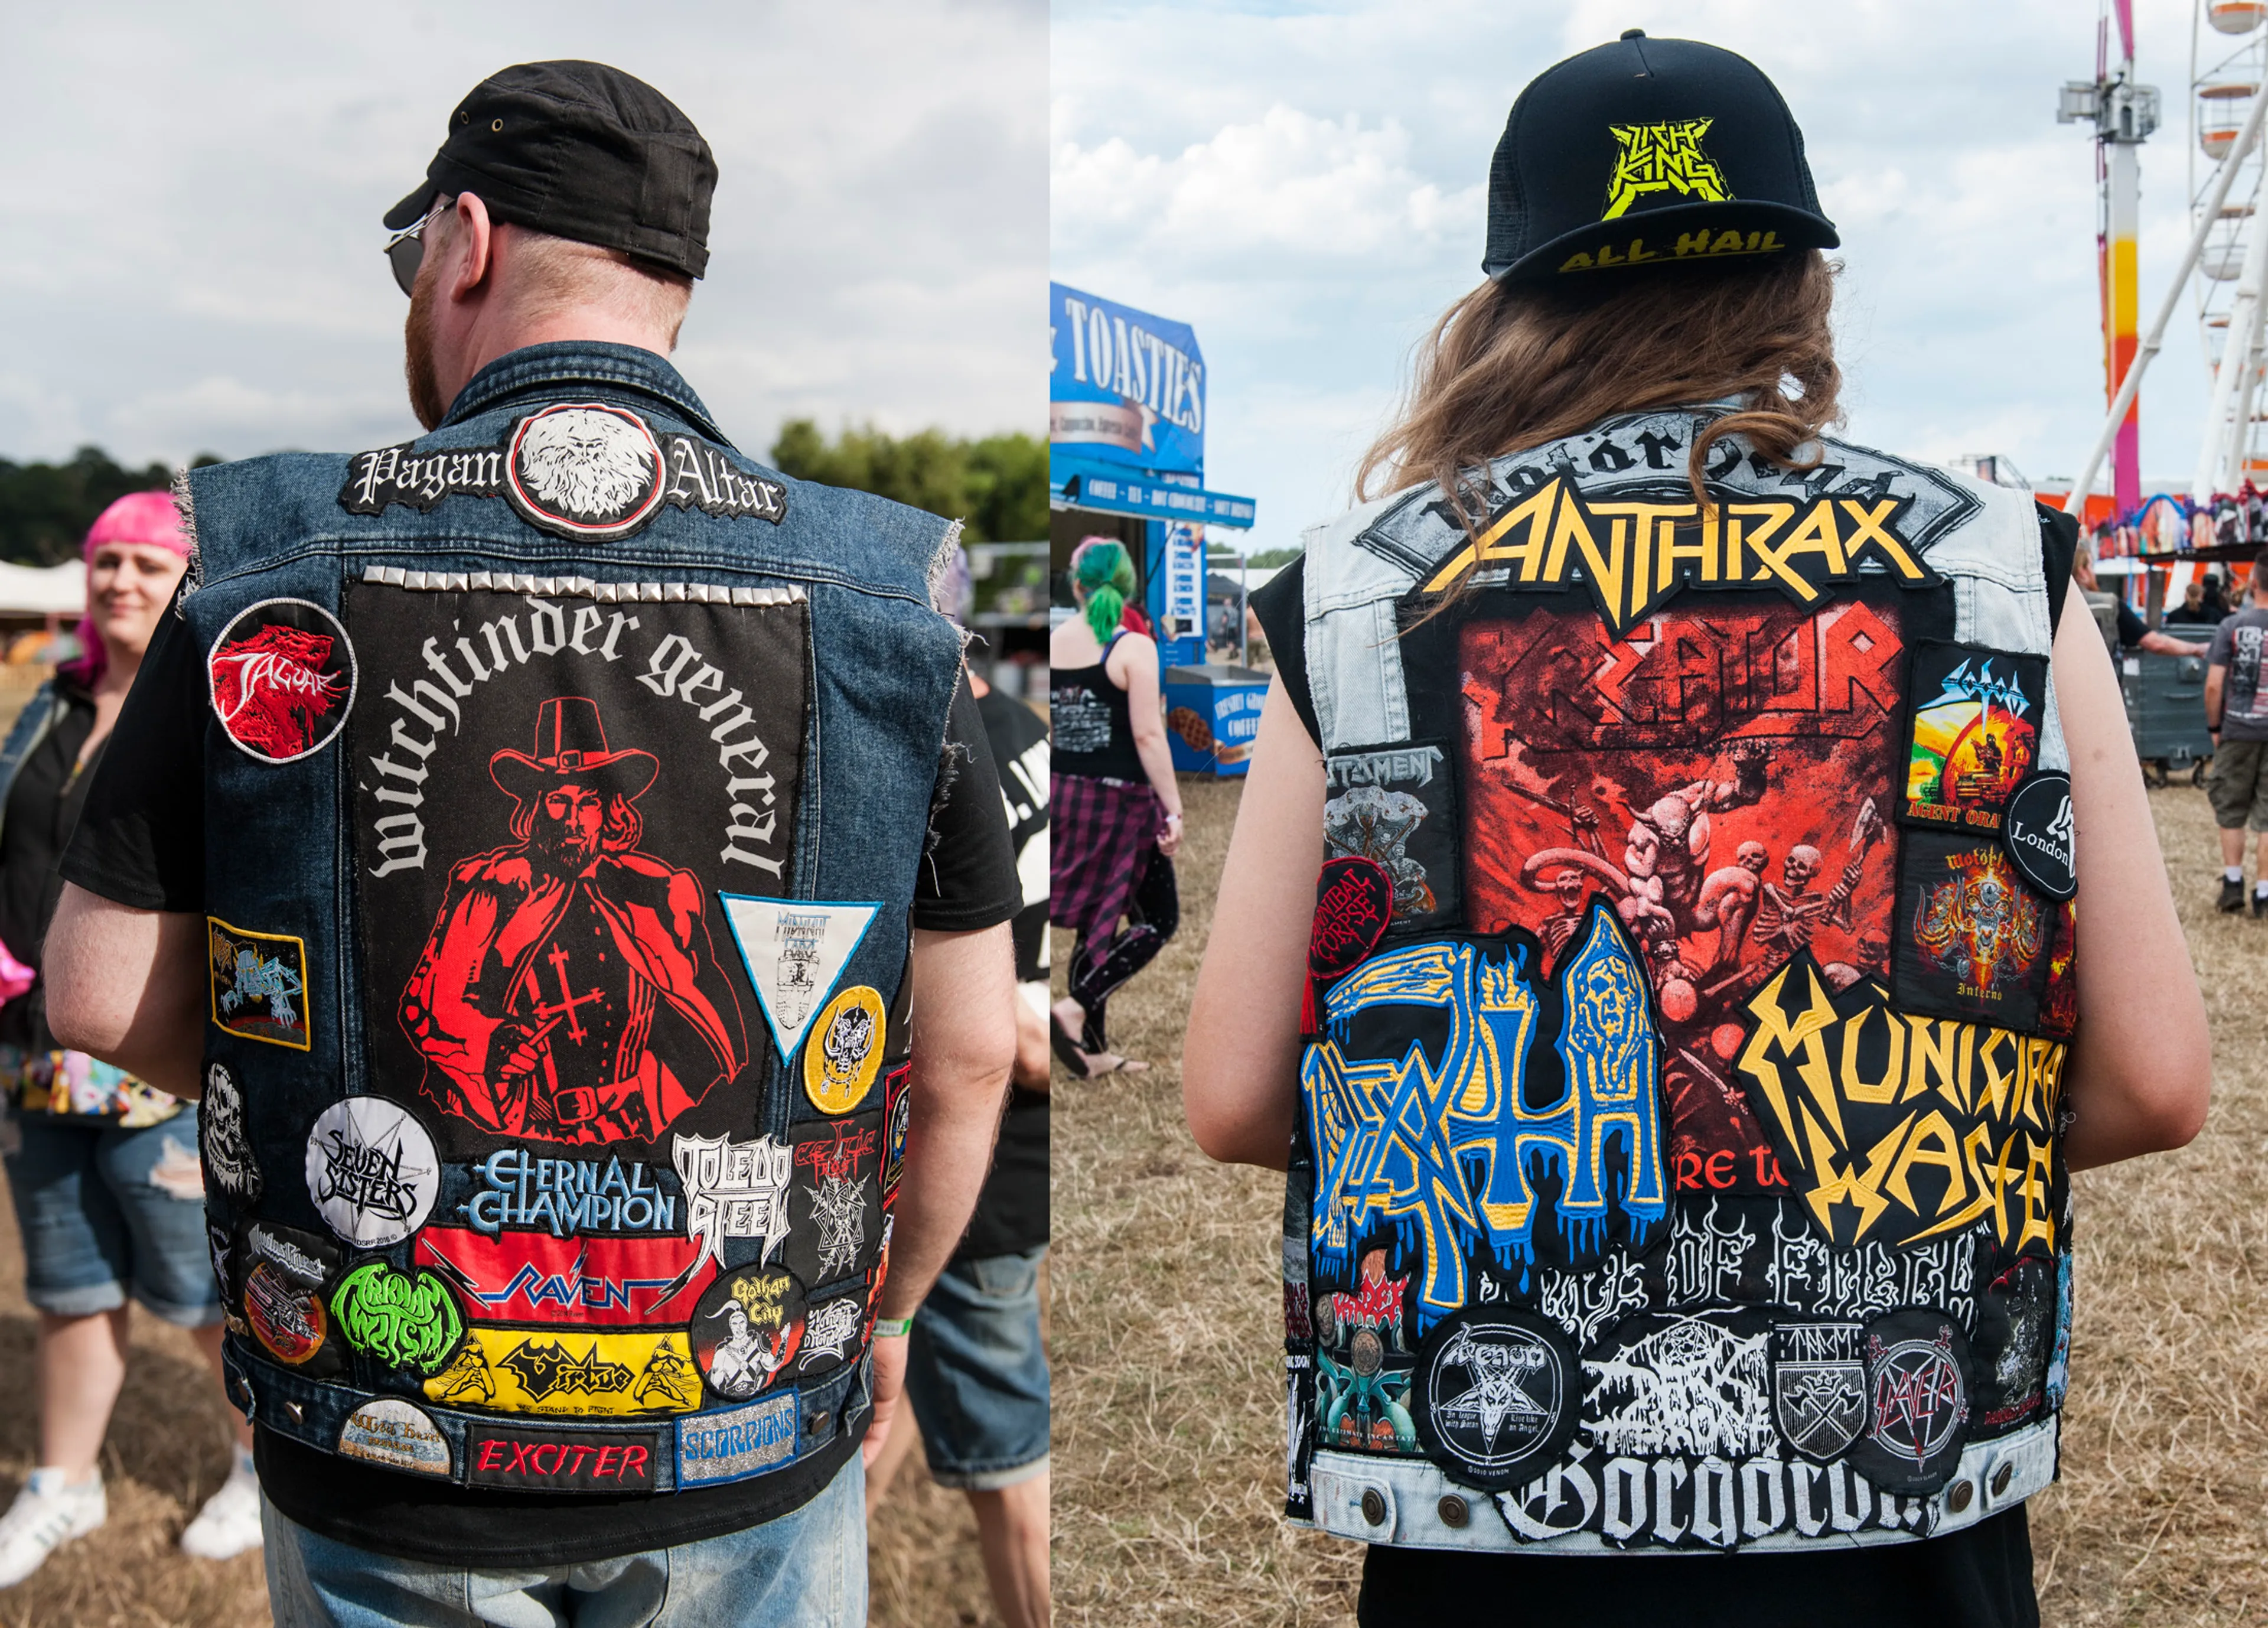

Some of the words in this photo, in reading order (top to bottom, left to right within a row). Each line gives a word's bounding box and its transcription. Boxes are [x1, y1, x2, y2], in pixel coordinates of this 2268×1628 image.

[1609, 145, 1723, 204] KING
[1558, 239, 1655, 272] ALL
[1674, 229, 1785, 256] HAIL
[1065, 297, 1203, 435] TOASTIES
[354, 447, 502, 506] Pagan
[666, 438, 780, 513] Altar
[1422, 476, 1925, 630] ANTHRAX
[212, 652, 338, 722] JAGUAR
[1461, 601, 1904, 762] KREATOR
[360, 596, 640, 878] witchfinder
[636, 633, 786, 880] general
[1907, 802, 1961, 822] AGENT
[1966, 810, 2002, 829] ORA
[2012, 822, 2070, 867] London
[1317, 893, 1380, 965] CORPSE
[1956, 982, 2003, 1001] Inferno
[1738, 963, 2067, 1158] MUNICIPA
[472, 1148, 654, 1205] ETERNAL
[672, 1131, 794, 1199] TOLEDO
[1797, 1096, 2055, 1257] WASTE
[457, 1181, 675, 1237] CHAMPION
[687, 1187, 791, 1280] STEEL
[478, 1259, 673, 1311] RAVEN
[1442, 1322, 1547, 1375] VENOM
[1875, 1361, 1957, 1437] SLAYER
[477, 1440, 649, 1483] EXCITER
[685, 1409, 795, 1460] SCORPIONS
[1367, 1432, 1419, 1441] INCANTATI
